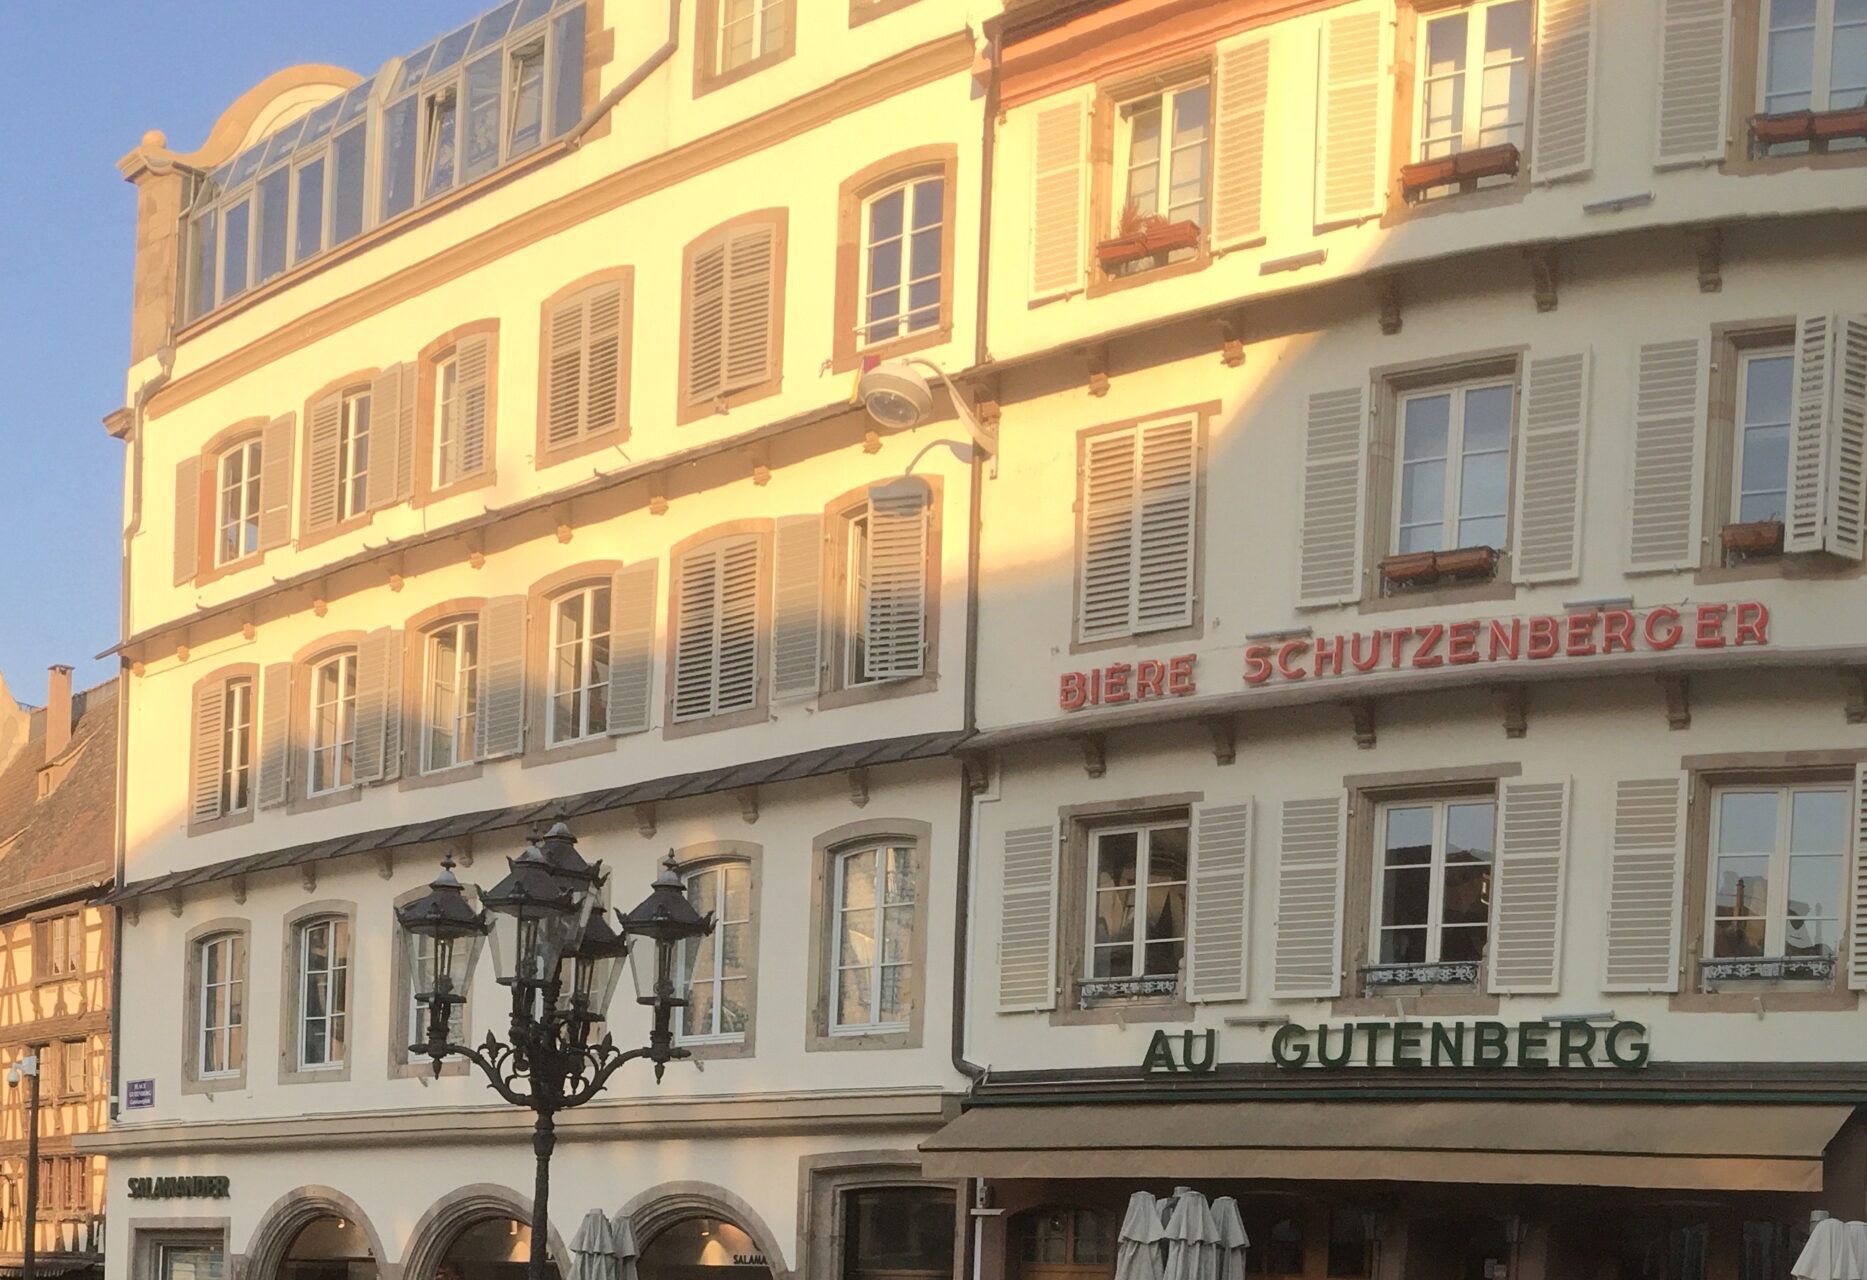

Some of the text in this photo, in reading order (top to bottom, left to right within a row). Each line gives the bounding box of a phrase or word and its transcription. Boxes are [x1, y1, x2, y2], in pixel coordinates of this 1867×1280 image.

[1242, 602, 1770, 685] SCHUTZENBERGER
[1142, 1020, 1649, 1072] AU GUTENBERG
[127, 1176, 231, 1200] SALAMANDER
[733, 1254, 768, 1265] SALAMA
